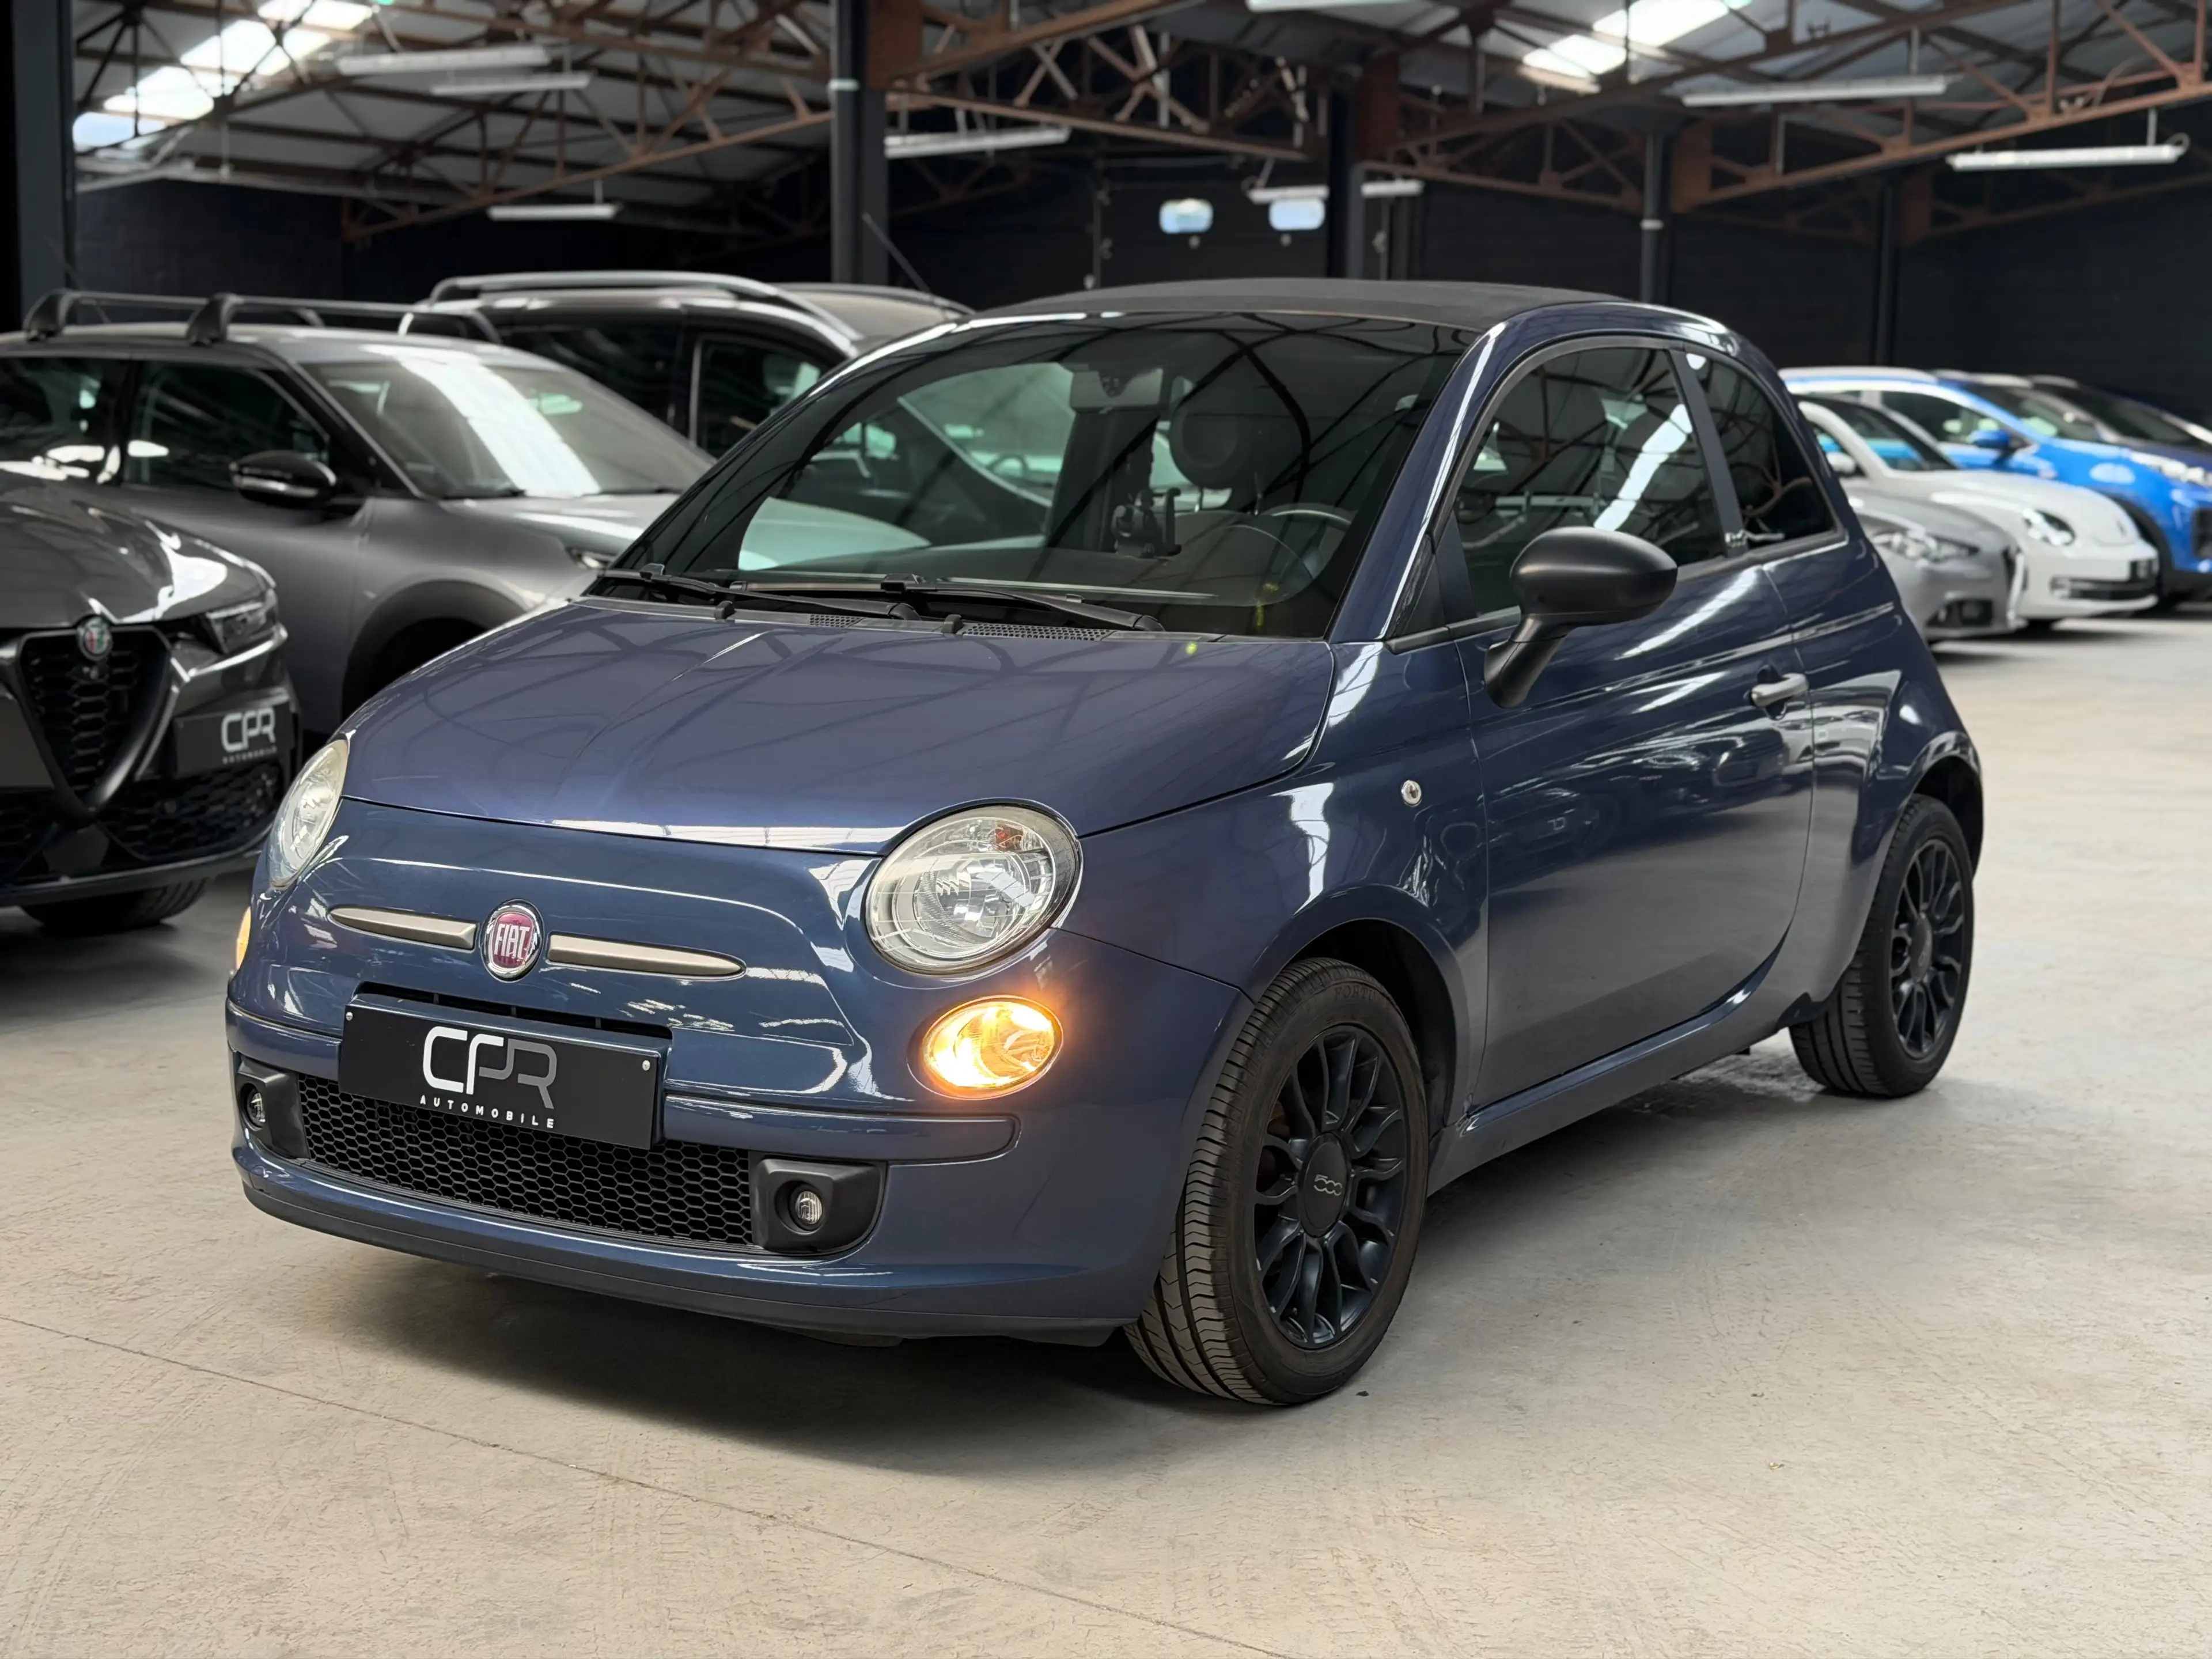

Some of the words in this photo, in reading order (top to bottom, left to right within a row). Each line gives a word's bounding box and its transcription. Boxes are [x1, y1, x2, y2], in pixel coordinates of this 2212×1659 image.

[221, 709, 275, 753] CPR
[494, 923, 530, 960] FIAT
[423, 1026, 557, 1109] CPR
[420, 1094, 554, 1128] AUTOMOBILE
[1313, 1174, 1343, 1196] 500
